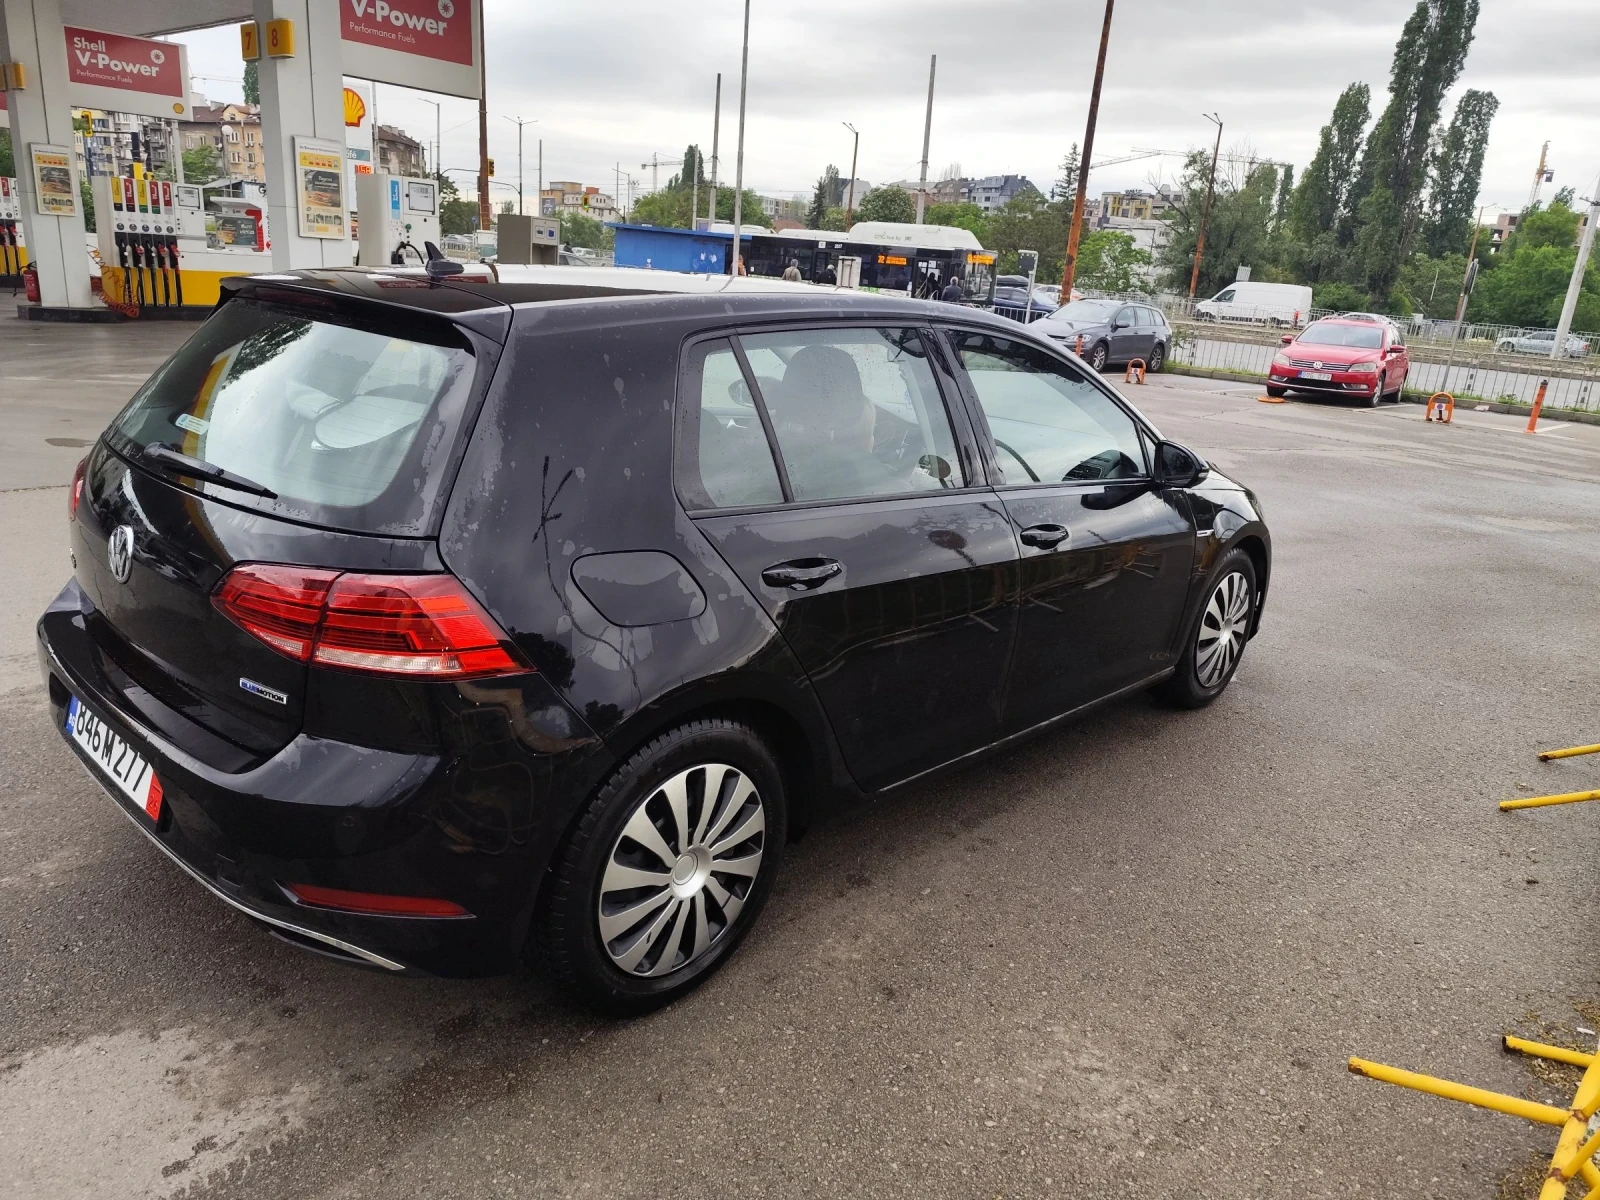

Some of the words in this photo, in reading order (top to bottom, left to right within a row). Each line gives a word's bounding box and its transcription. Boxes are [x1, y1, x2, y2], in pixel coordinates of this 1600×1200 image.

[350, 0, 448, 36] V-Power
[245, 31, 252, 51] 7
[271, 27, 279, 48] 8
[349, 21, 397, 40] Performance
[397, 31, 416, 44] Fuels
[73, 36, 106, 53] Shell
[75, 49, 160, 77] V-Power
[76, 68, 117, 81] Performance
[117, 74, 133, 84] Fuels
[346, 149, 357, 159] afé
